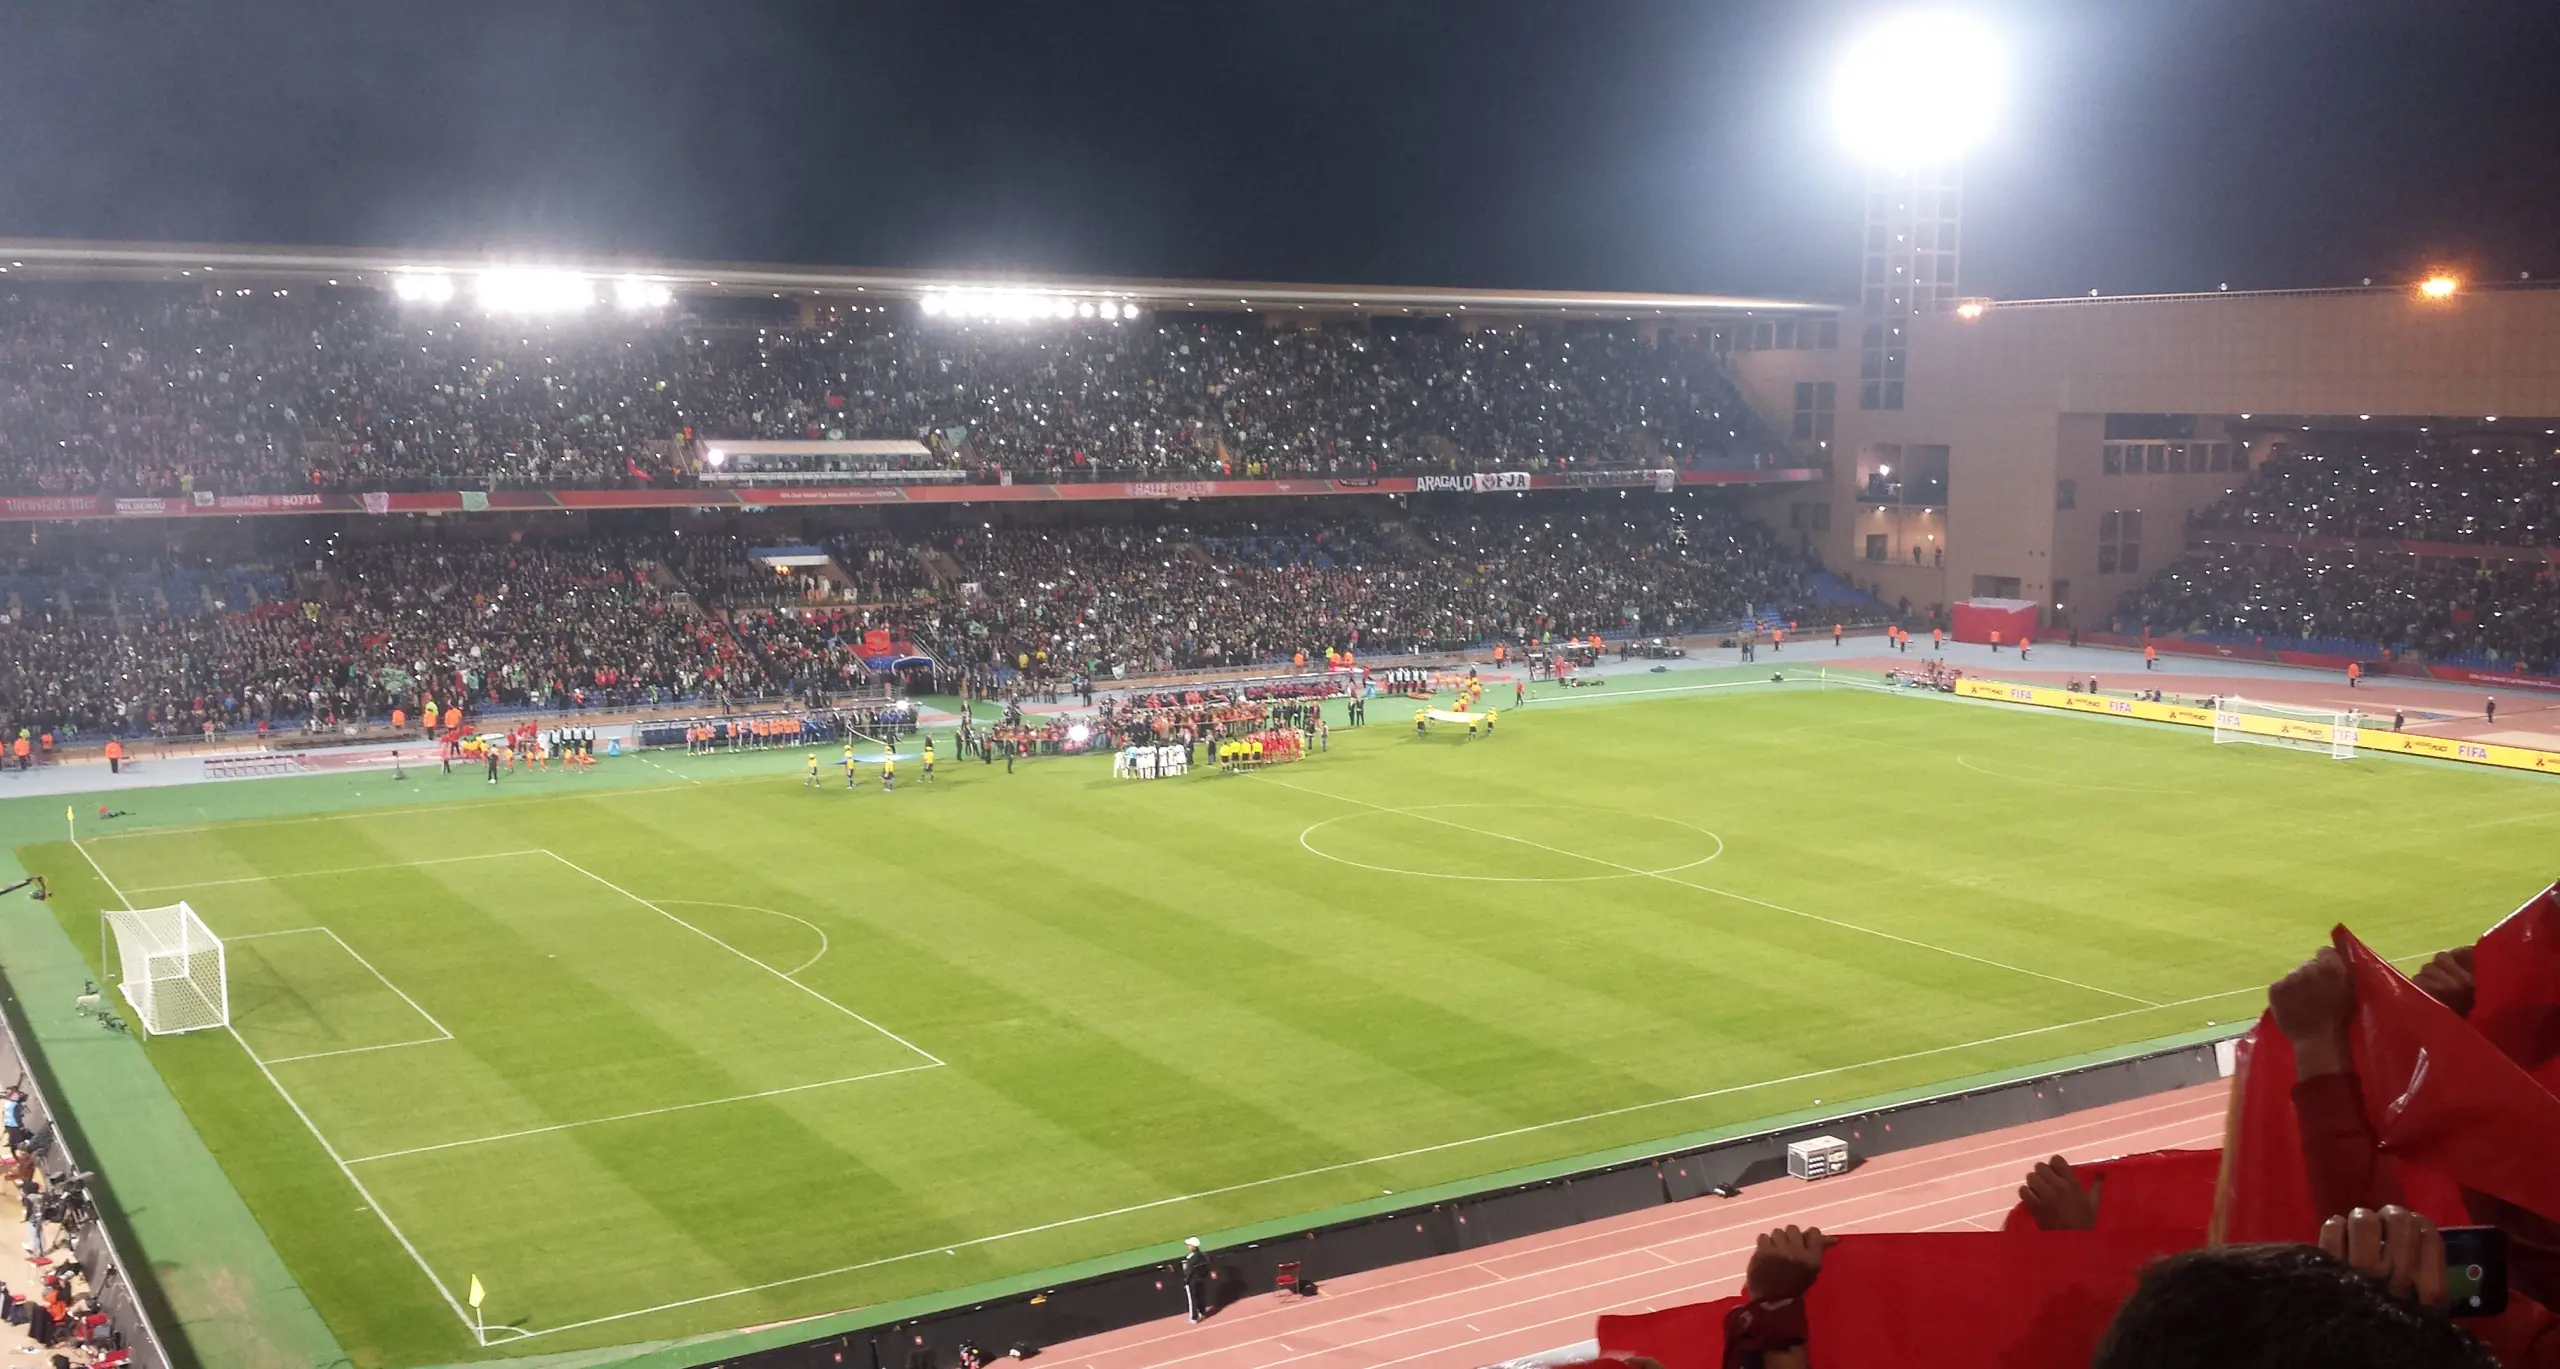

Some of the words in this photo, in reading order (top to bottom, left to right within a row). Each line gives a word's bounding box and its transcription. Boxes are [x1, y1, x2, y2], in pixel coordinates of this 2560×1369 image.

[1416, 475, 1473, 492] ARAGALO
[2011, 688, 2032, 699] FIFA
[2109, 701, 2132, 713] FIFA
[2458, 745, 2487, 759] FIFA
